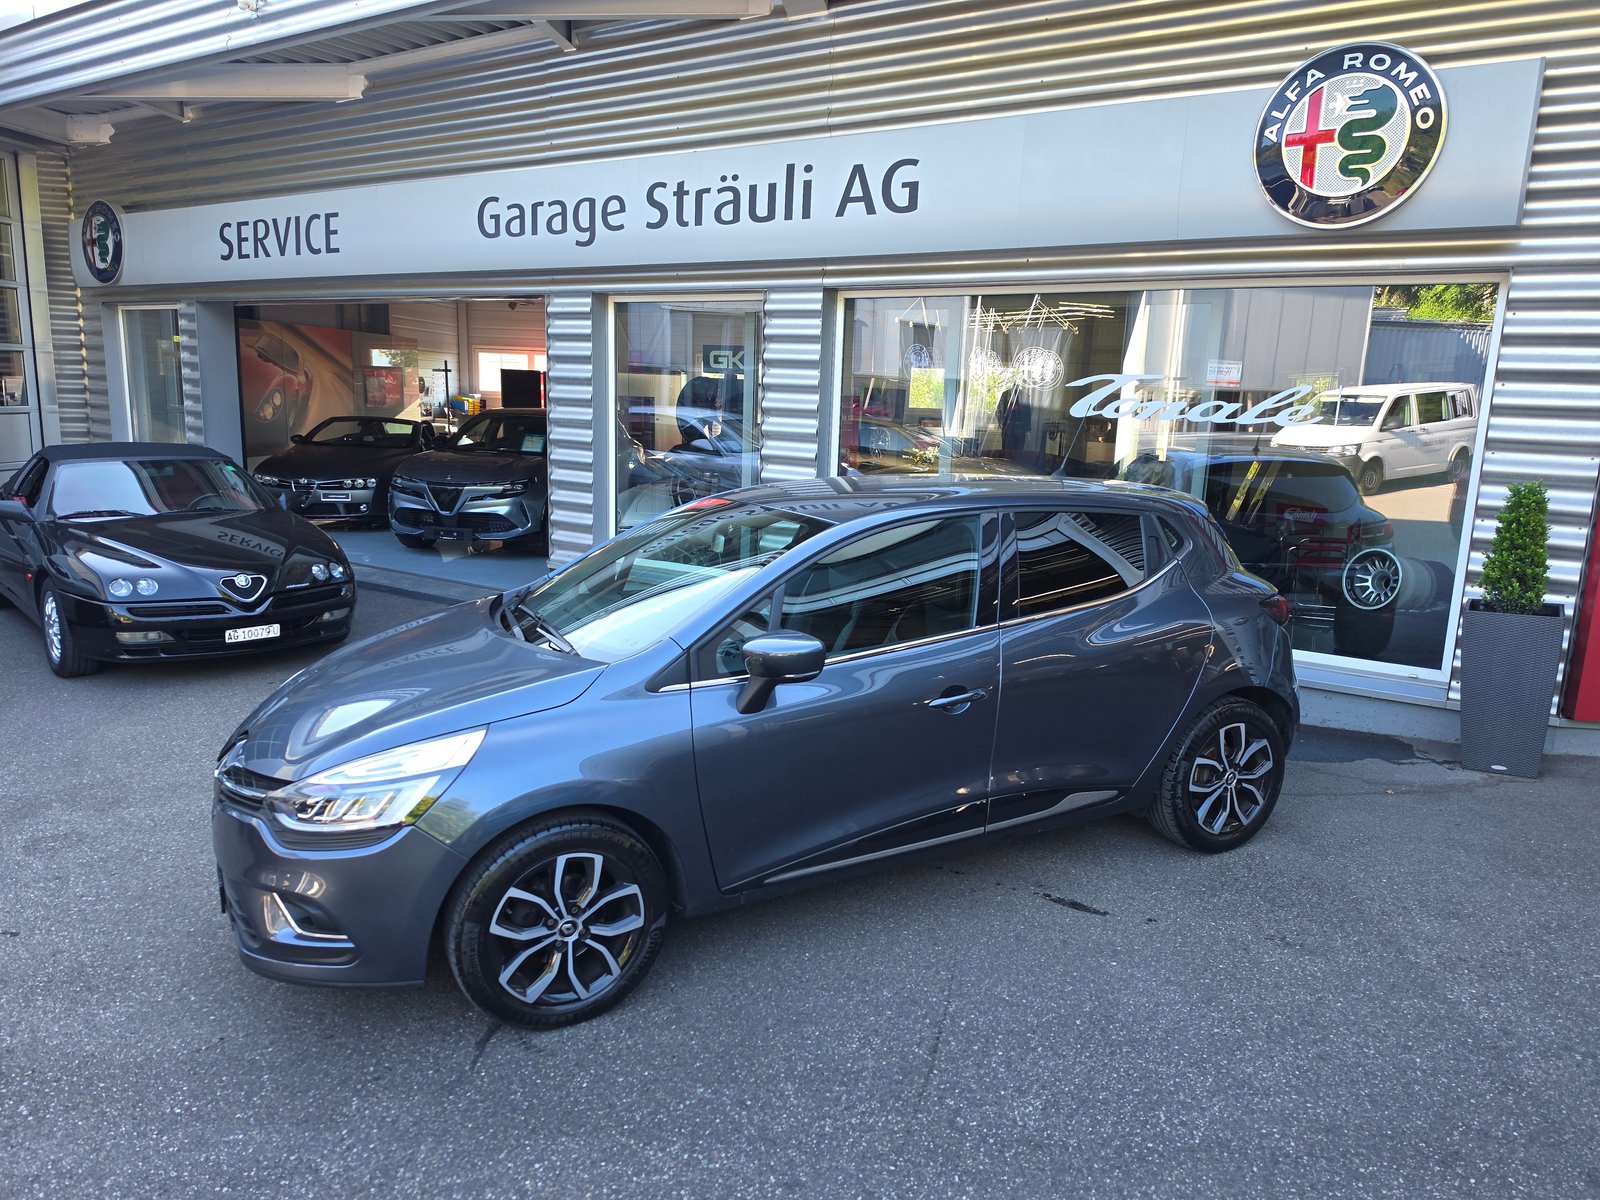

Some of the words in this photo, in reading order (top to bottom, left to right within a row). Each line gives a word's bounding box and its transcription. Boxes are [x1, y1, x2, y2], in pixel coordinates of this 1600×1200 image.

[1264, 68, 1325, 143] ALFA
[1343, 52, 1435, 130] ROMEO
[477, 195, 627, 247] Garage
[645, 163, 814, 229] Sträuli
[835, 158, 920, 218] AG
[218, 212, 340, 261] SERVICE
[709, 350, 745, 369] GK
[1065, 373, 1324, 427] Tonale
[227, 630, 239, 641] AG
